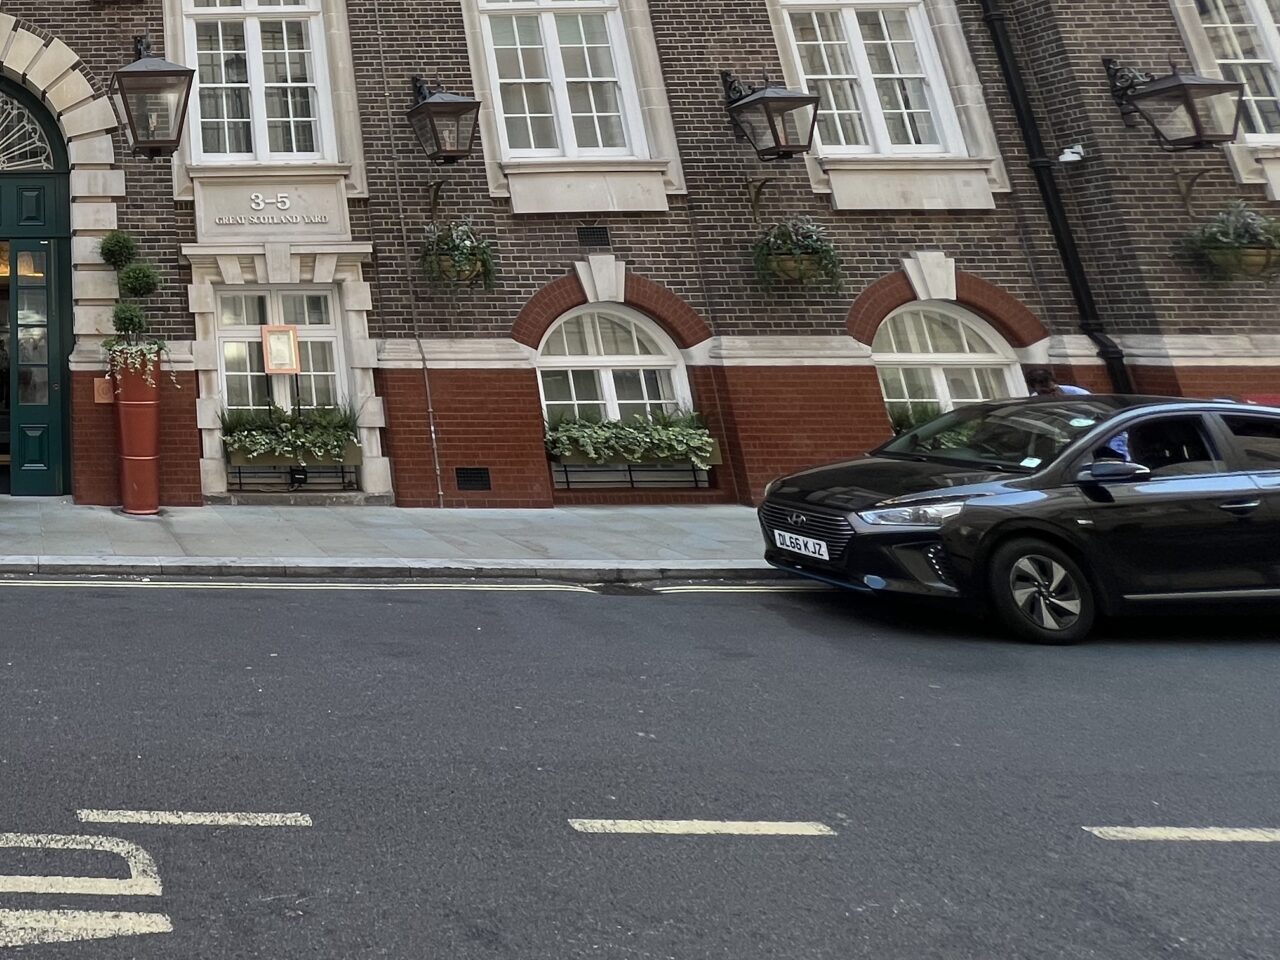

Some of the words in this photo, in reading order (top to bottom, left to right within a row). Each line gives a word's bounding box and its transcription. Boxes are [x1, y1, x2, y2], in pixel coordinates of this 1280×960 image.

[250, 192, 291, 211] 3-5
[215, 215, 246, 226] GREAT
[248, 214, 300, 225] SCOTLAND
[302, 214, 329, 225] YARD
[778, 533, 802, 551] DL66
[803, 539, 824, 557] KJZ
